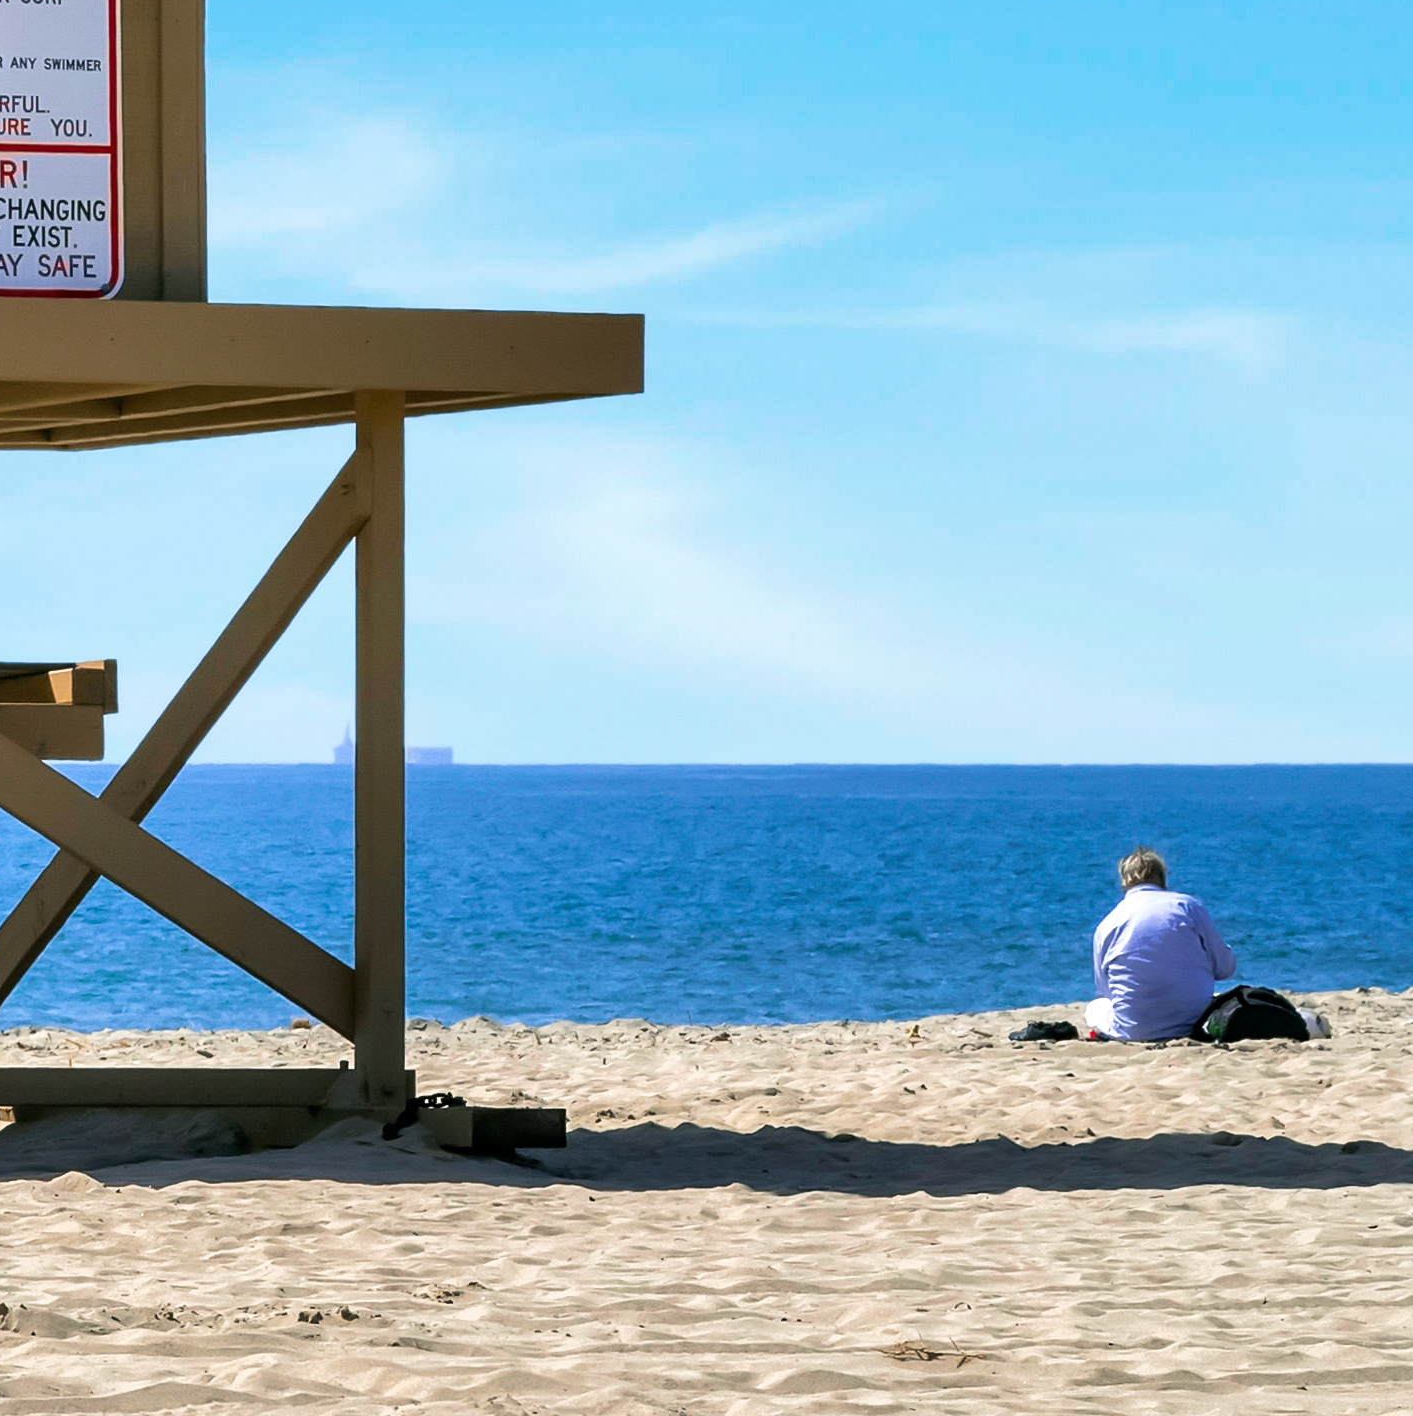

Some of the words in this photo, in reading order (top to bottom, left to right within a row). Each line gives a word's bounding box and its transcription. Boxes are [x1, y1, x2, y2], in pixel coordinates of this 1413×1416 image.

[11, 57, 36, 70] ANY
[44, 58, 101, 72] SWIMMER
[51, 119, 92, 137] YOU.
[13, 226, 77, 249] EXIST.
[38, 254, 97, 278] SAFE
